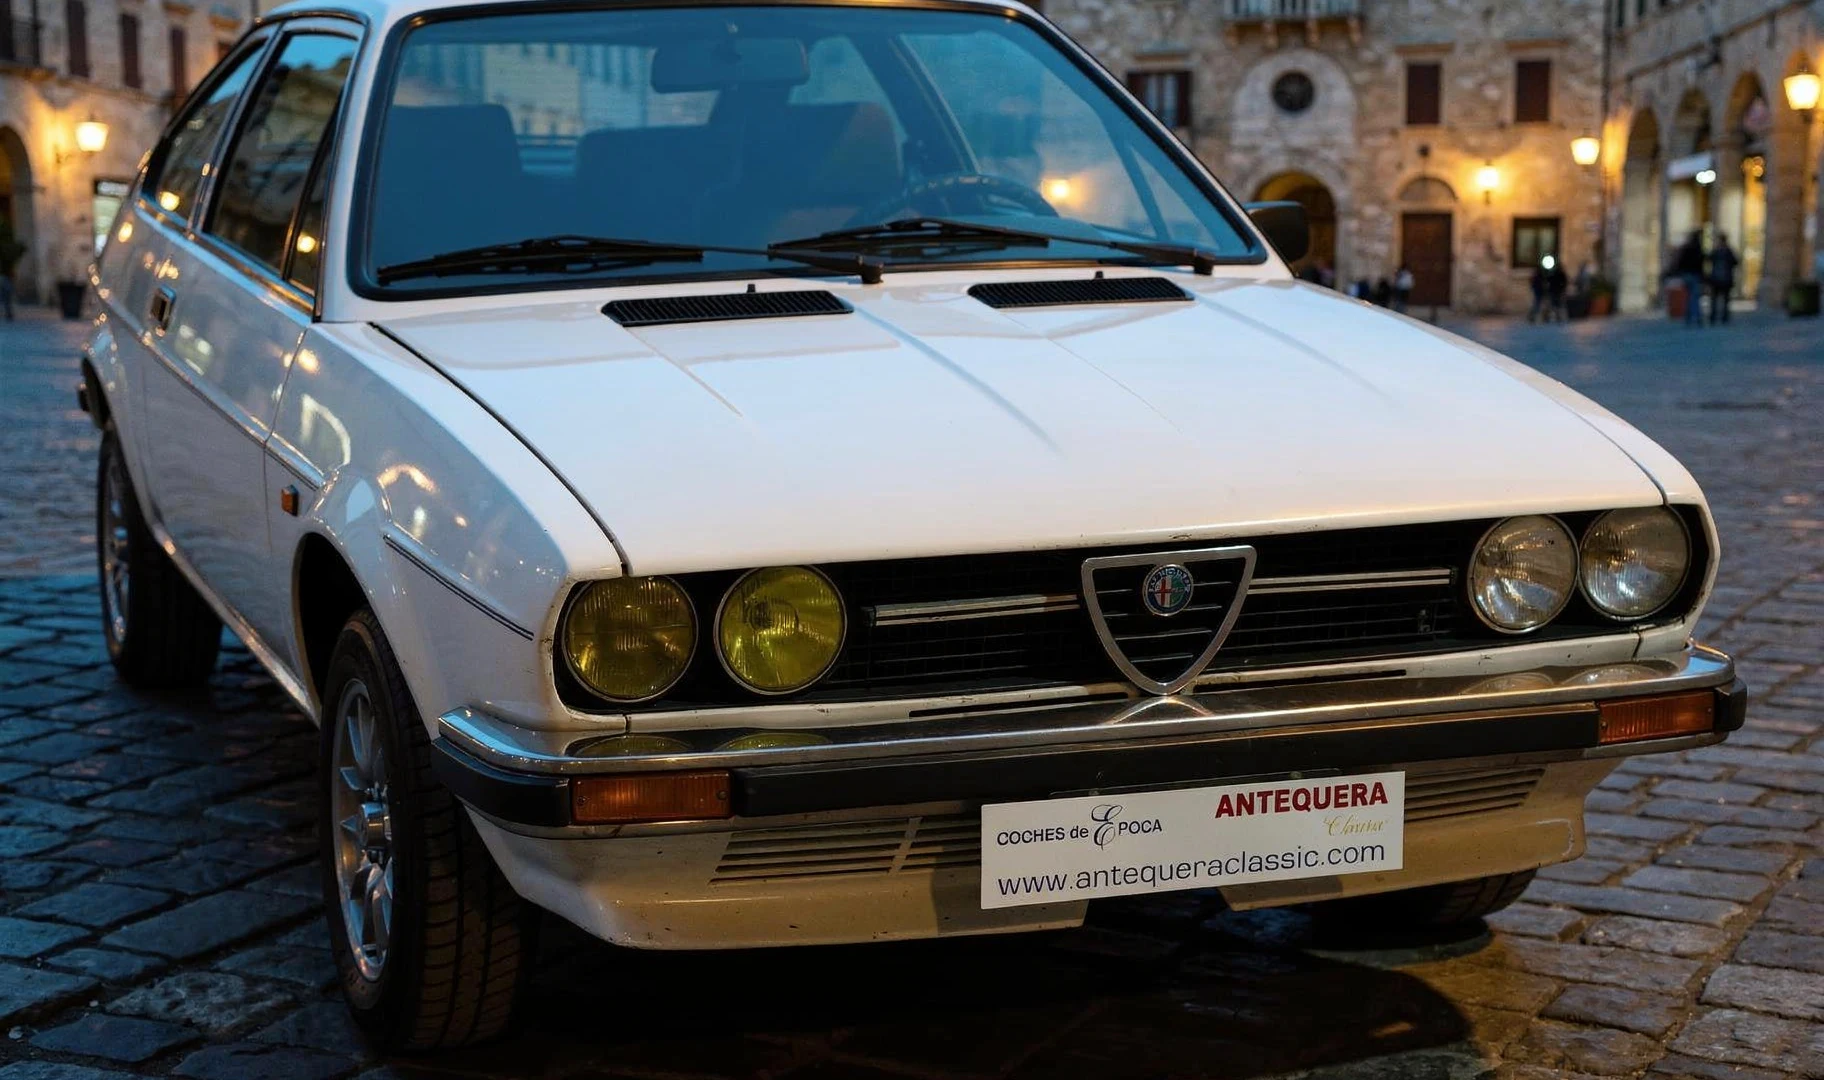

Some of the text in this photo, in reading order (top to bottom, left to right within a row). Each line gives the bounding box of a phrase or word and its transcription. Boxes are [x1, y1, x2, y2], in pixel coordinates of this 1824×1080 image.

[1215, 781, 1389, 818] ANTEQUERA
[996, 826, 1066, 846] COCHES
[1069, 824, 1089, 839] de
[997, 844, 1385, 896] www.antequeraclassic.com
